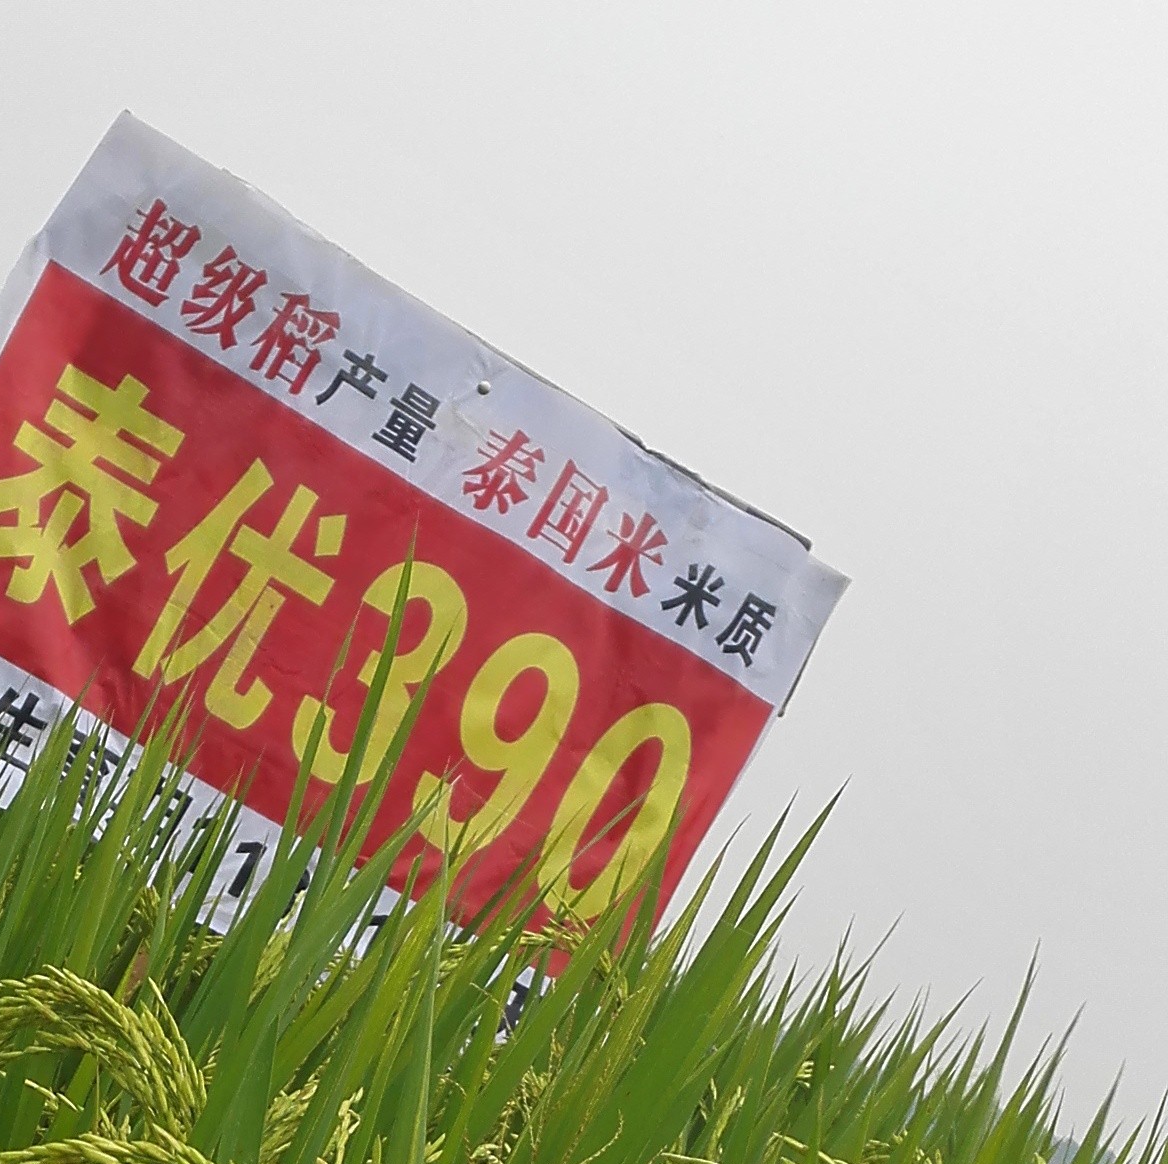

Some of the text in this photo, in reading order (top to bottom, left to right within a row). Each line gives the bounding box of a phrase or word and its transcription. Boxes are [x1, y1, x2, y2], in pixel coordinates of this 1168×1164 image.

[99, 198, 777, 667] 超级稻产量 泰国米米质
